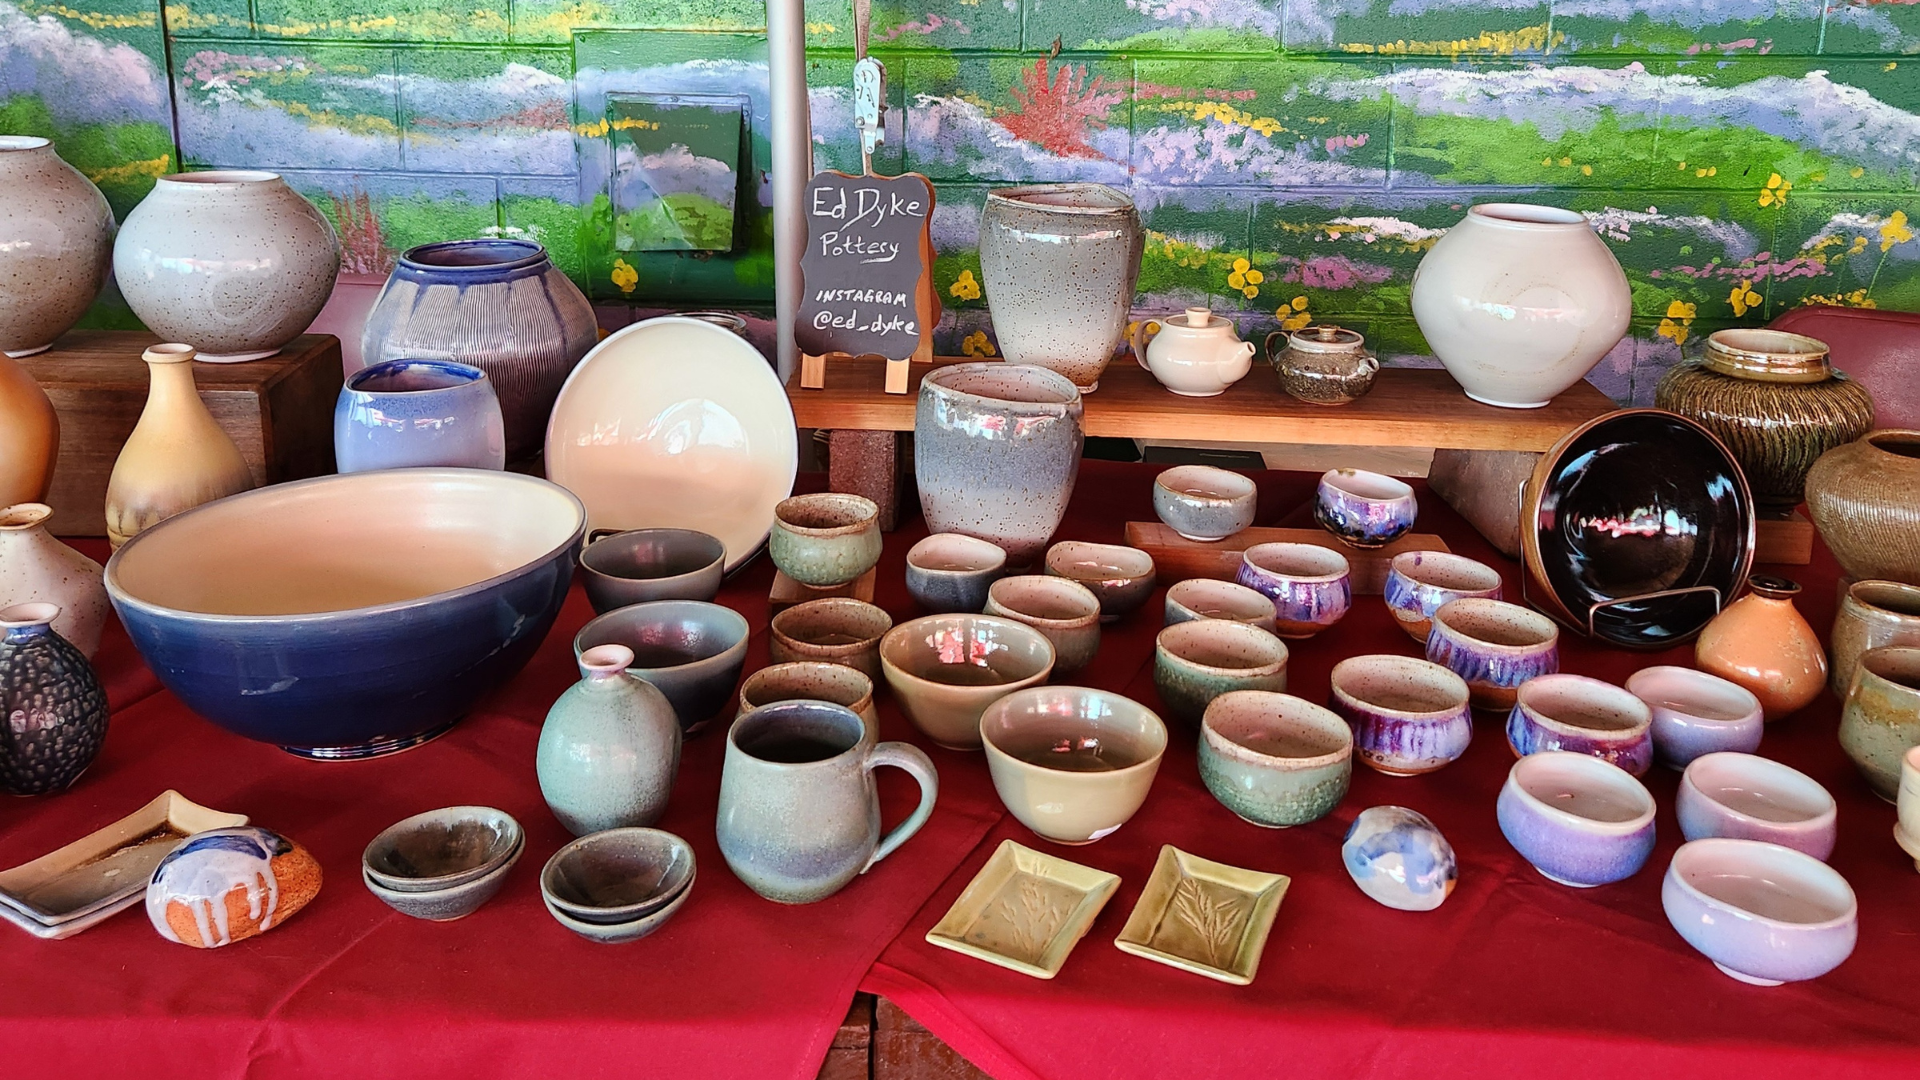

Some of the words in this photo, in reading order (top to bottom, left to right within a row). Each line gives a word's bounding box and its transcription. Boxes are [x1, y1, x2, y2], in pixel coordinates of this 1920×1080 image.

[812, 187, 846, 219] Ed
[840, 188, 926, 232] Dyke
[819, 231, 900, 264] Pottery
[815, 289, 907, 308] INSTAGRAM
[813, 310, 918, 336] @ed_dyke
